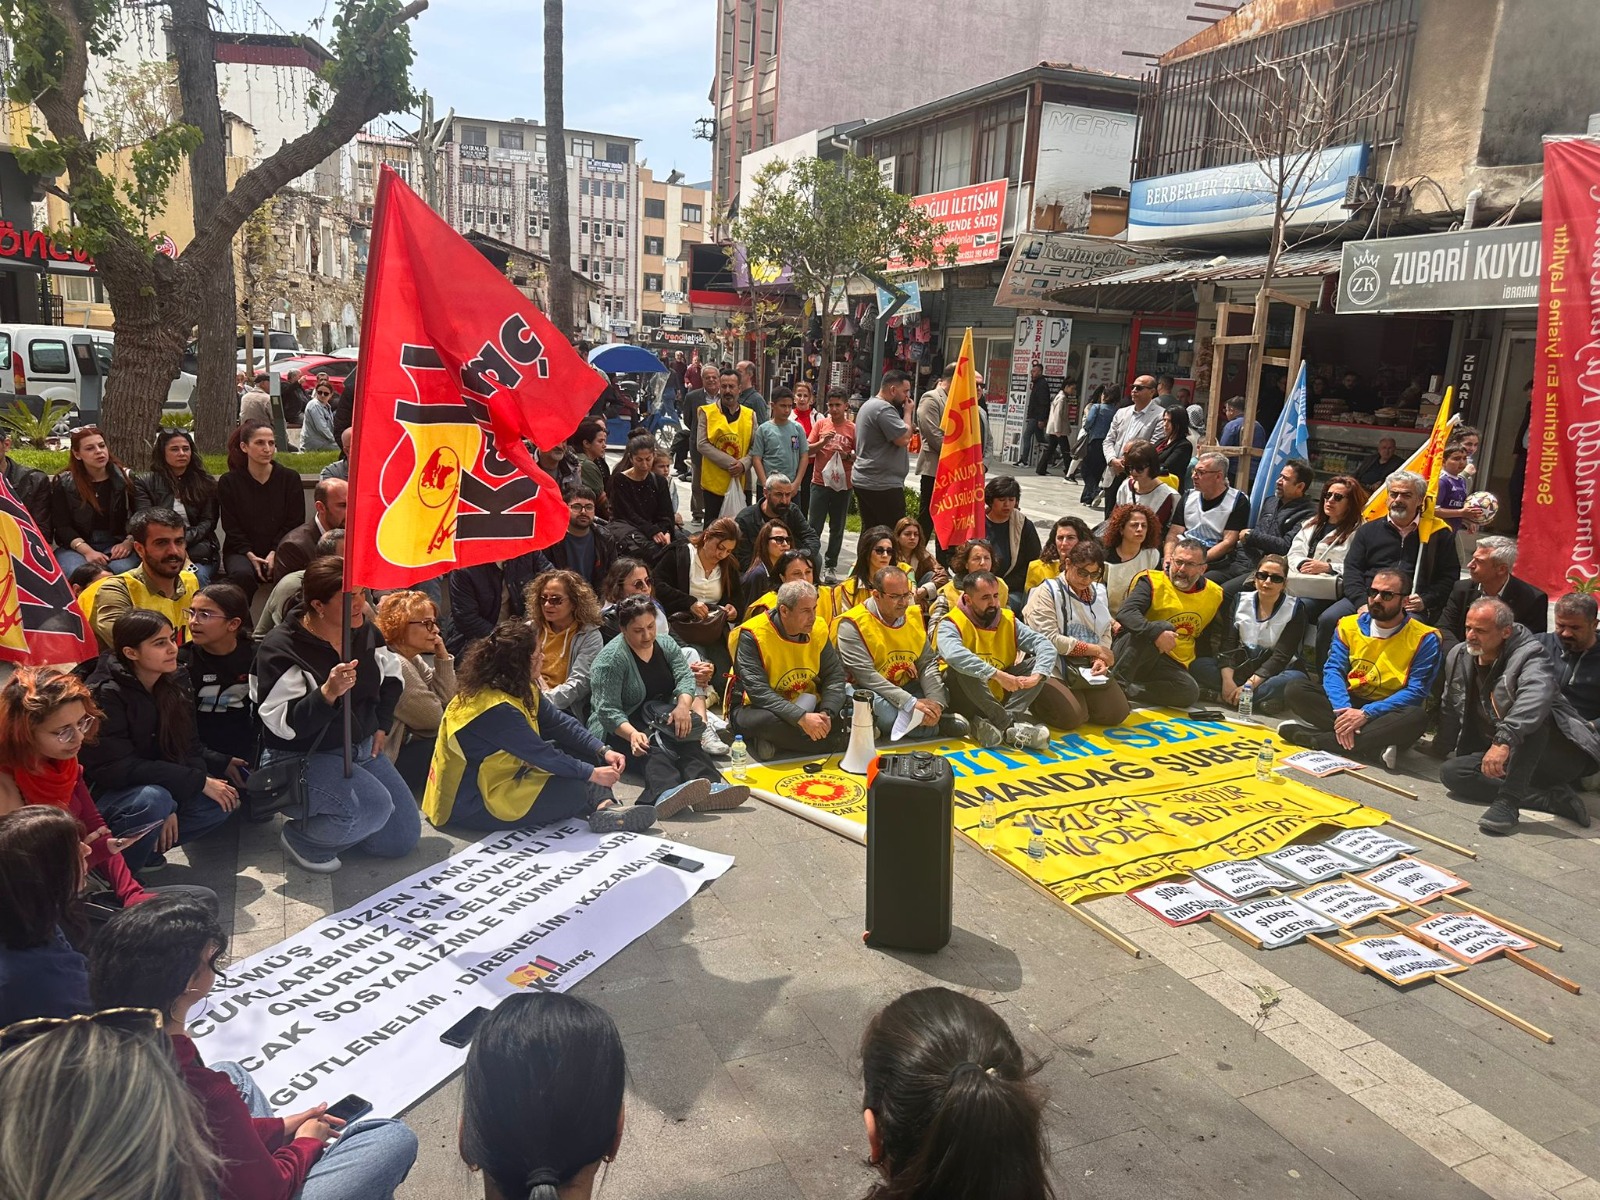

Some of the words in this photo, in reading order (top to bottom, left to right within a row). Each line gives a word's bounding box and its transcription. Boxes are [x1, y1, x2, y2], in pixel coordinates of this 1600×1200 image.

[1048, 110, 1128, 137] MERT
[914, 197, 949, 220] OĞLU
[951, 187, 999, 215] İLETİŞİM
[1145, 179, 1218, 206] BERBERLER
[973, 213, 998, 230] SATIŞ
[1041, 242, 1131, 268] Kerimoğlu
[1389, 239, 1470, 286] ZUBARİ
[1013, 259, 1122, 279] İLETİŞ
[1351, 276, 1376, 293] ZK
[1502, 282, 1538, 300] İBRAHİM
[1458, 354, 1476, 409] ZUBARİ
[1171, 615, 1194, 625] ĞİTİM
[943, 732, 1115, 778] İTİM
[1101, 716, 1238, 750] SEN
[1150, 735, 1282, 777] ŞUBESİ
[829, 807, 856, 816] CAK
[319, 892, 415, 941] DÜZEN
[410, 857, 485, 892] YAMA
[477, 815, 559, 856] TUTMA
[393, 893, 456, 925] İÇİN
[454, 840, 551, 893] GÜVENLİ
[546, 825, 580, 842] VE
[1229, 898, 1293, 919] YALNIZLIK
[1319, 896, 1336, 904] TEK
[1336, 900, 1351, 910] HEP
[313, 915, 505, 1022] SOSYALİZMLE
[498, 831, 639, 916] MÜMKÜNDÜR!
[1255, 909, 1301, 928] ŞİDDET
[1269, 918, 1320, 940] ÜRETİR!
[267, 950, 396, 1016] ONURLU
[393, 922, 449, 951] BİR
[444, 862, 552, 922] GELECEK
[527, 949, 596, 993] Kaldıraç
[269, 994, 448, 1113] GÜTLENELİM
[456, 913, 571, 986] DİRENELİM
